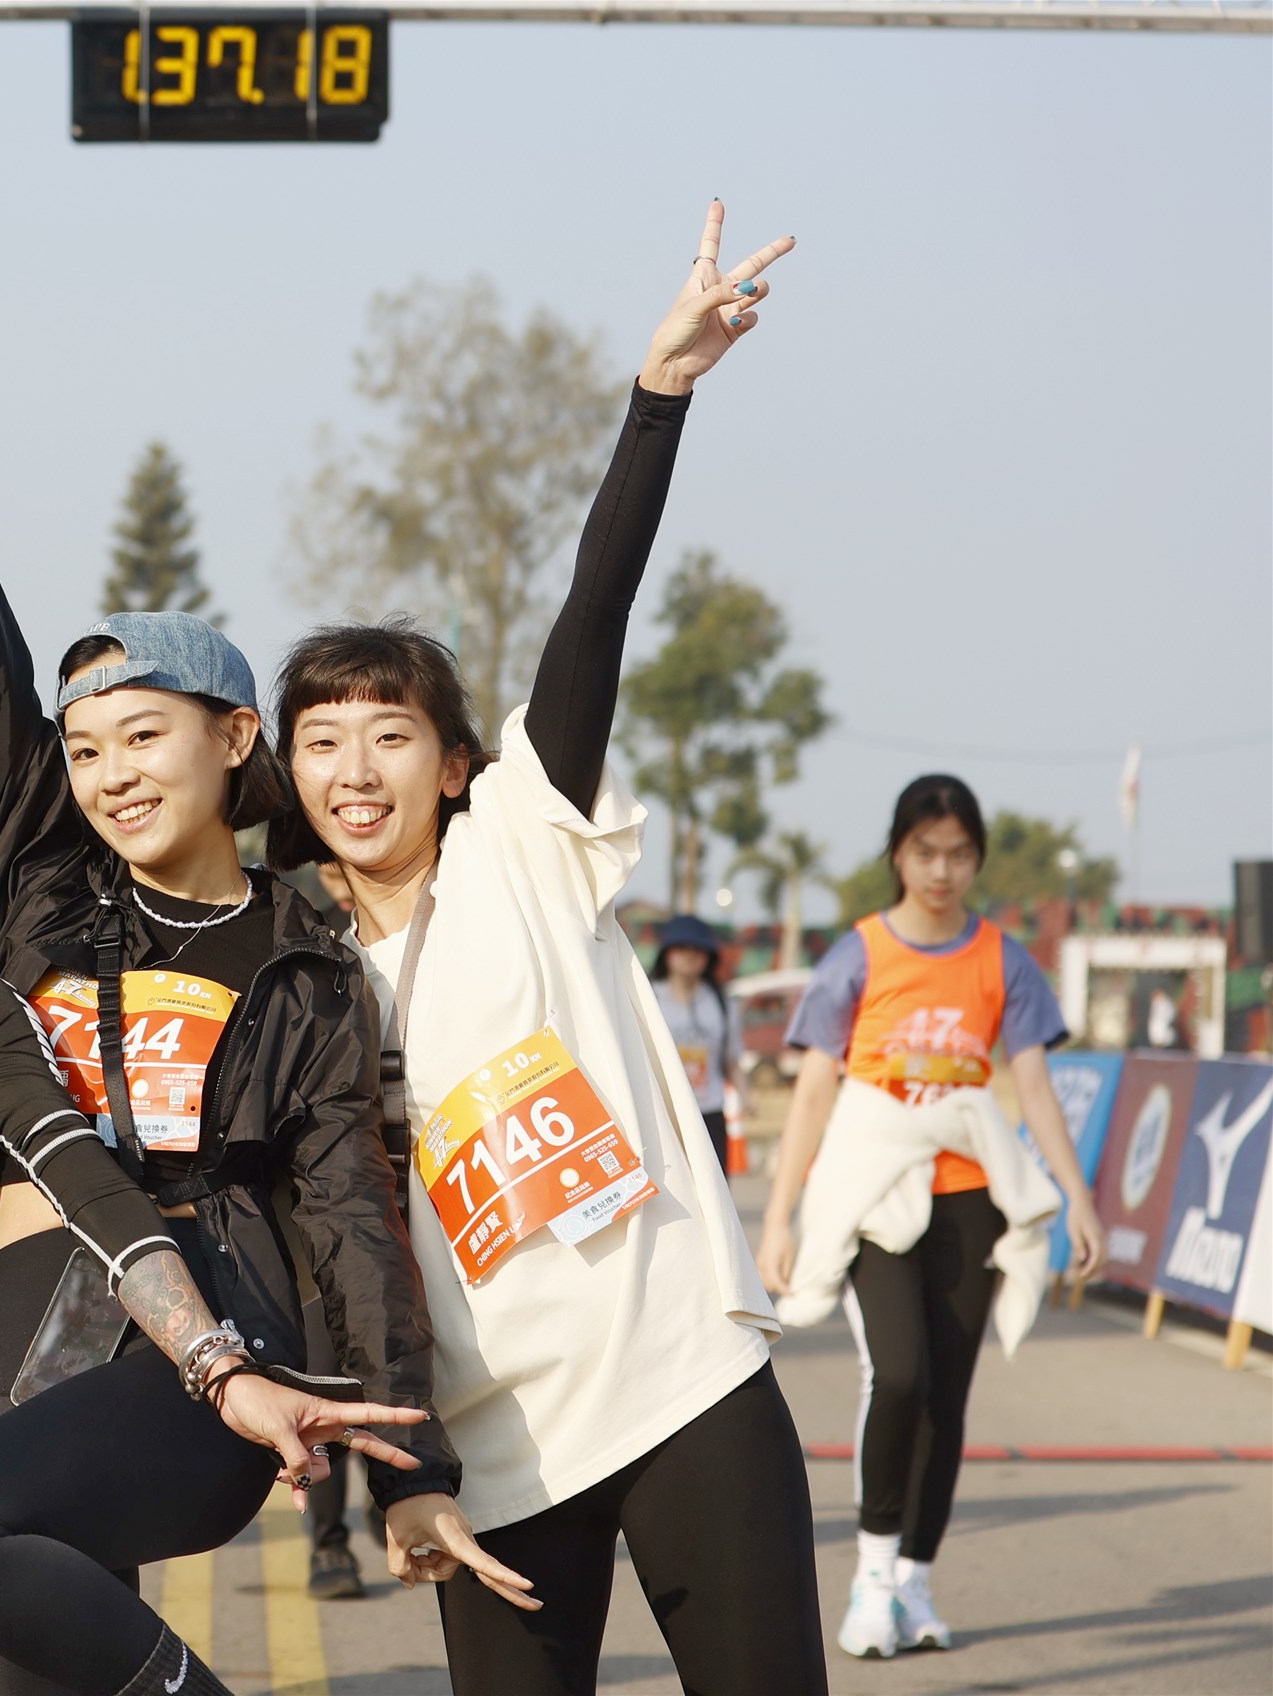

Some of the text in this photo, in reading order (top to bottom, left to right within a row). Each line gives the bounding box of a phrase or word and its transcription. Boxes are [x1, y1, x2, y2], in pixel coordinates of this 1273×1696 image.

[58, 971, 99, 990] MARATHO
[48, 1005, 184, 1060] 7144
[909, 1006, 965, 1050] 47
[447, 1096, 575, 1215] 7146
[591, 1202, 621, 1222] Food Voucher
[477, 1246, 494, 1267] CHING
[491, 1229, 511, 1249] HSIEN
